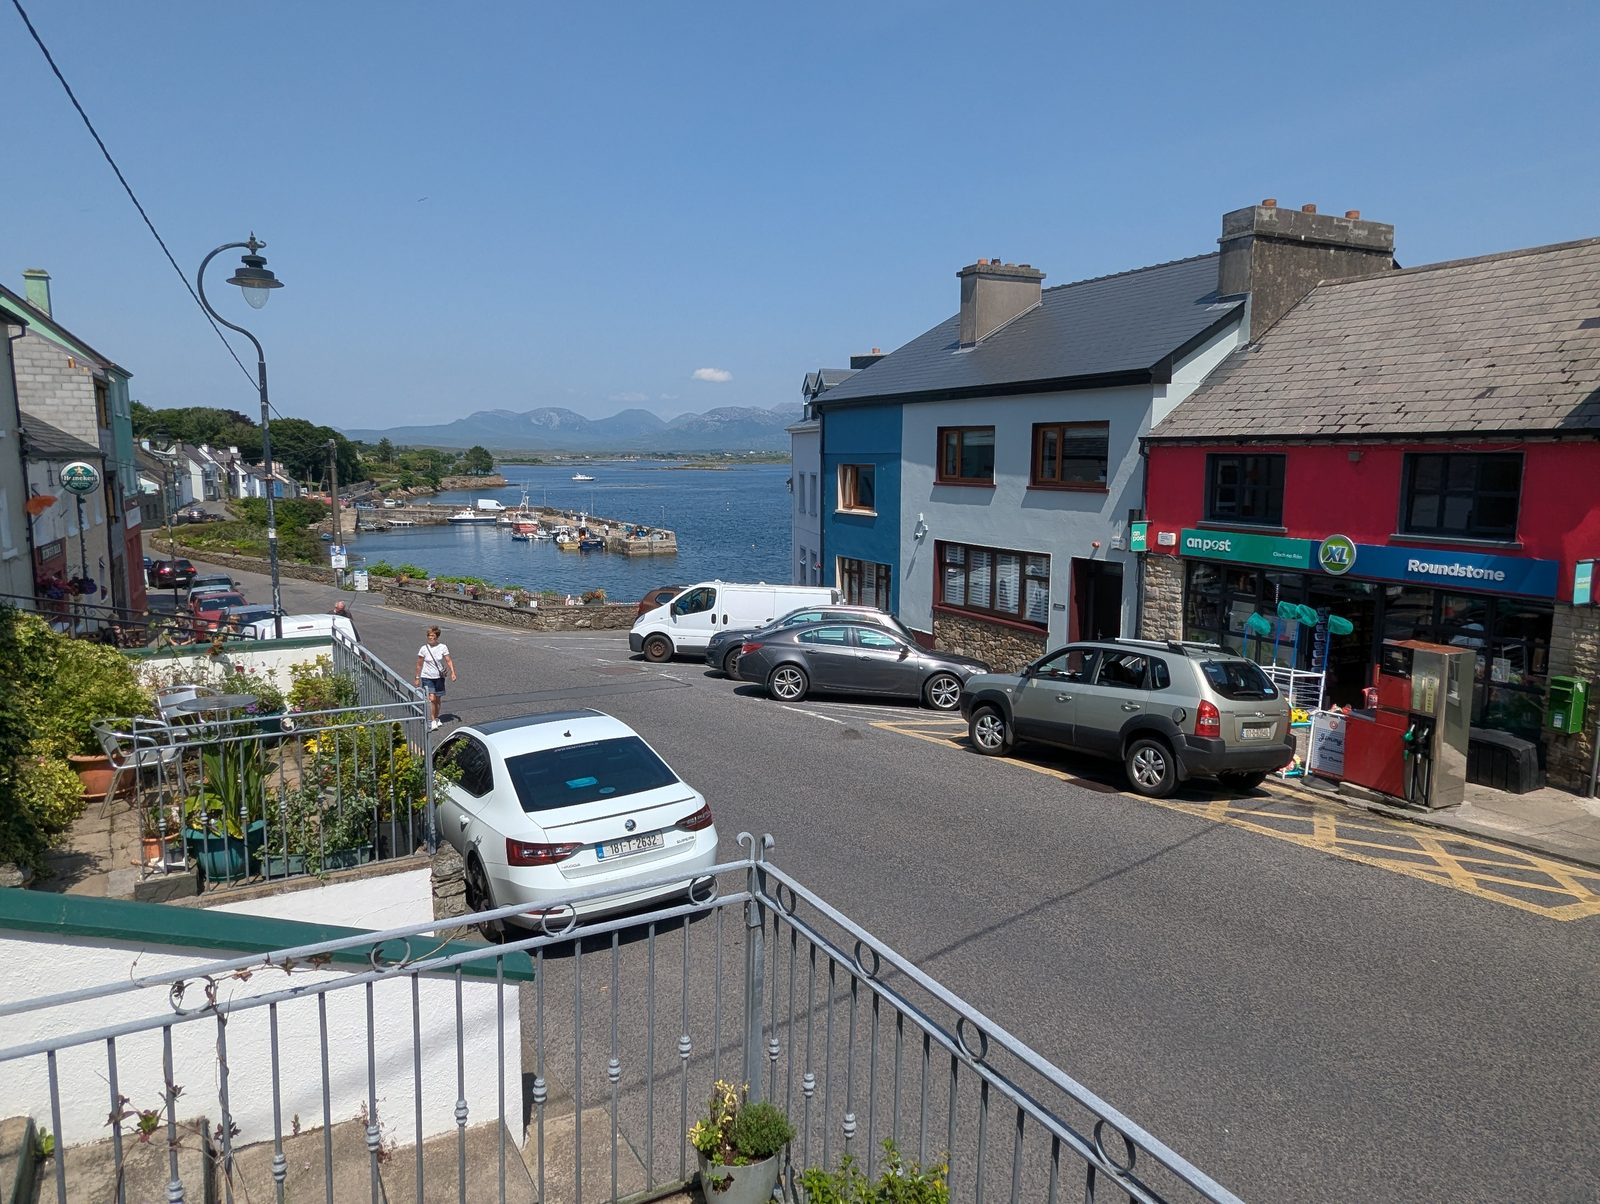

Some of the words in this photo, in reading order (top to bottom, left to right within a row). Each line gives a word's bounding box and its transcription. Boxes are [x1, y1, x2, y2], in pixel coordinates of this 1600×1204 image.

[1322, 545, 1349, 564] XL
[1408, 558, 1505, 581] Roundstone
[610, 835, 658, 855] 181-T-2632
